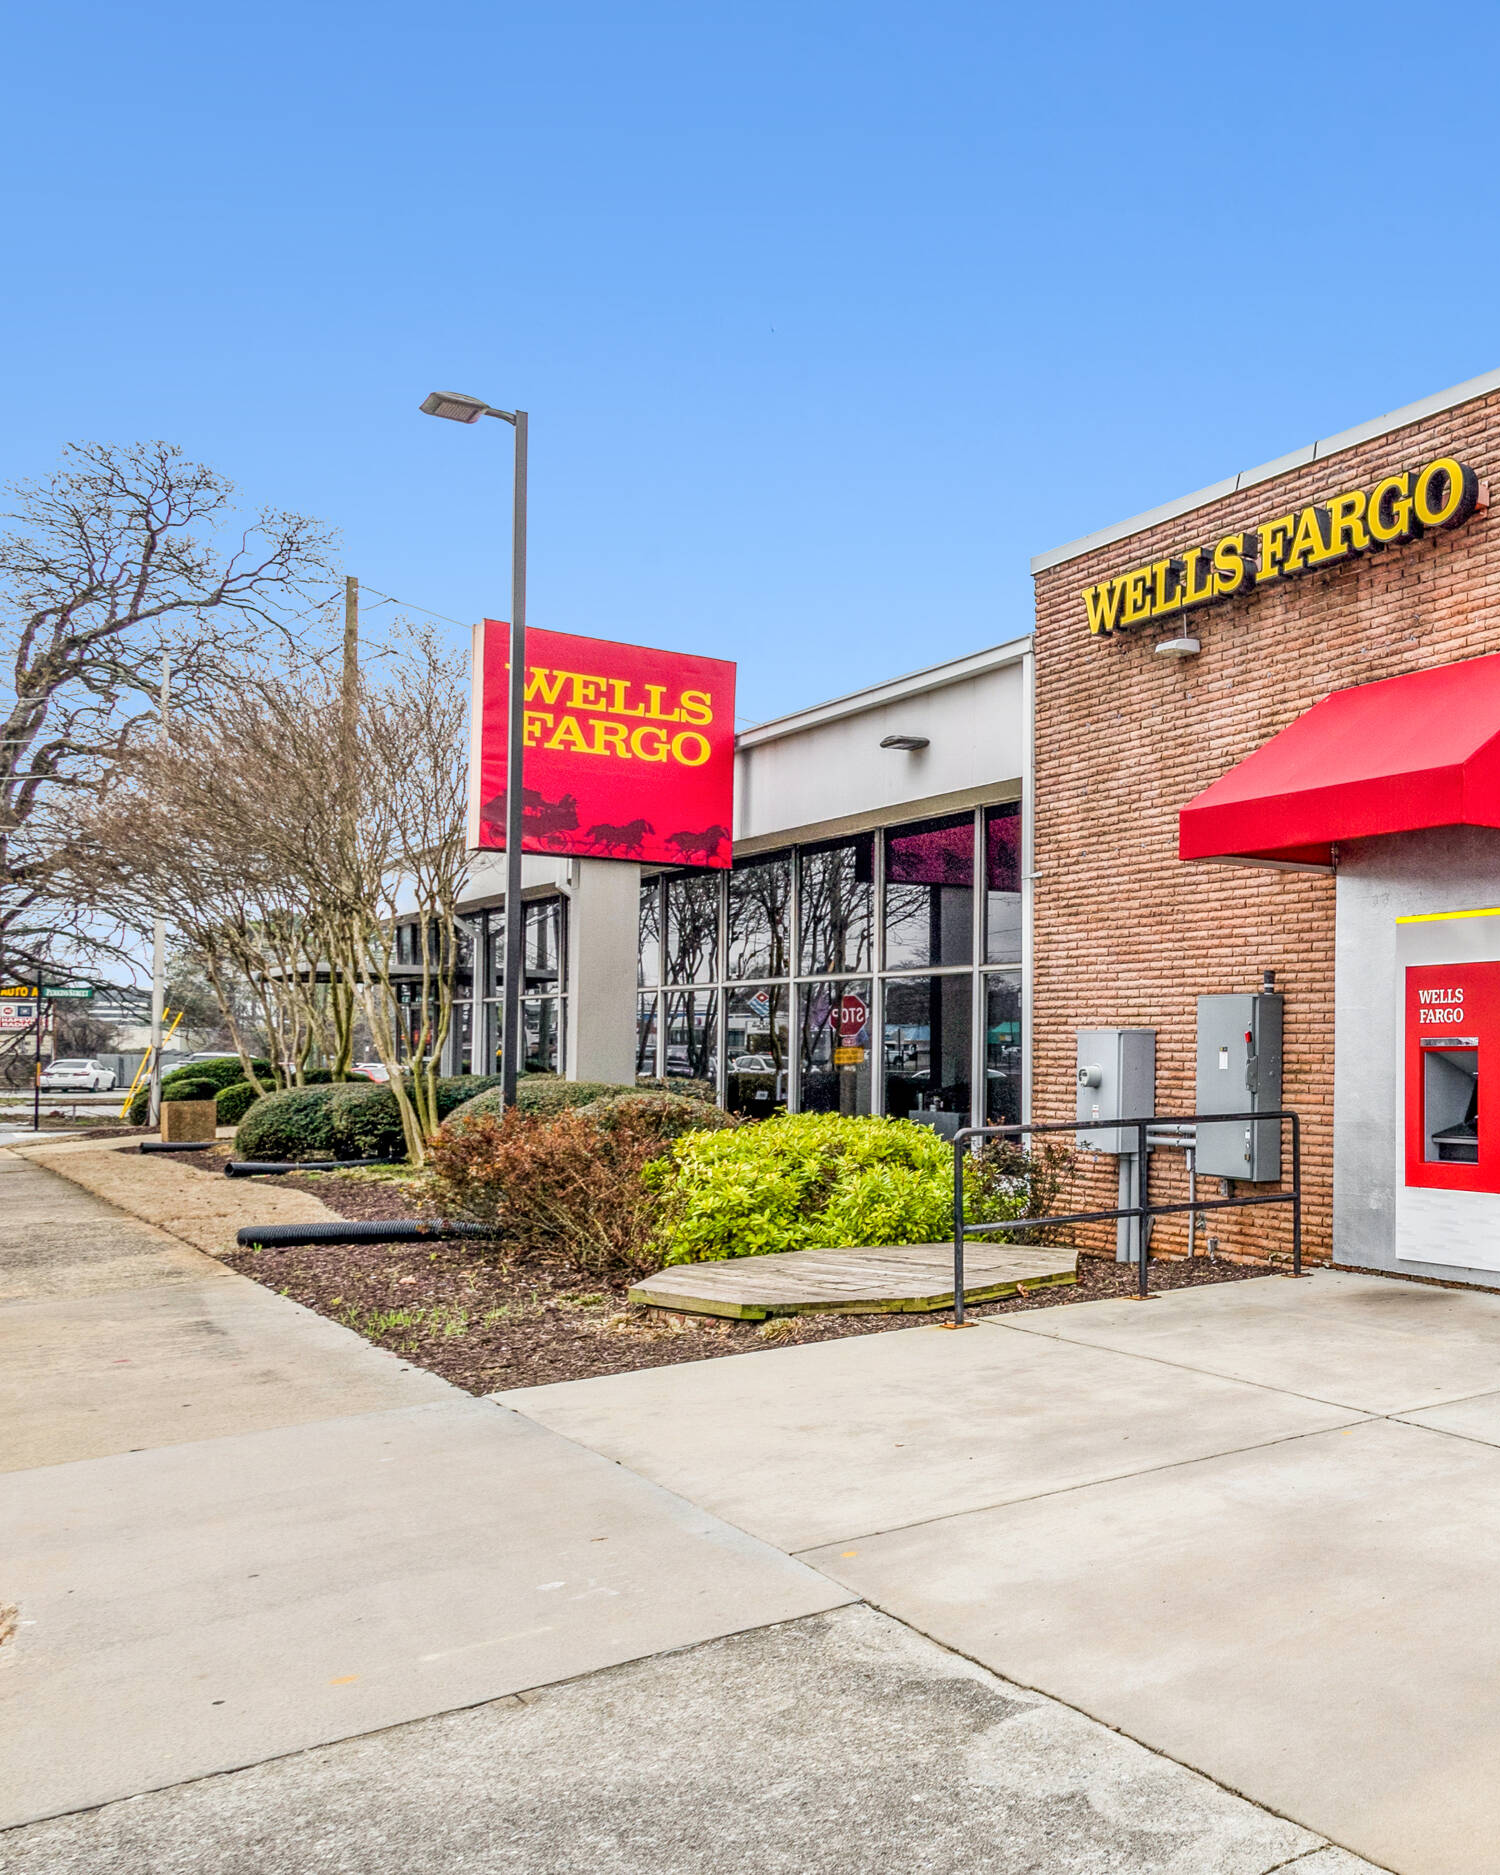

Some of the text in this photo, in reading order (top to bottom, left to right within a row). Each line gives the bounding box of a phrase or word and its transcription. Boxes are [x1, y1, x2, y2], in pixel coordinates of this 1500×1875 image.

[1081, 457, 1466, 634] WELLS FARGO
[505, 663, 714, 767] WELLS FARGO
[1418, 988, 1464, 1024] WELLS FARGO
